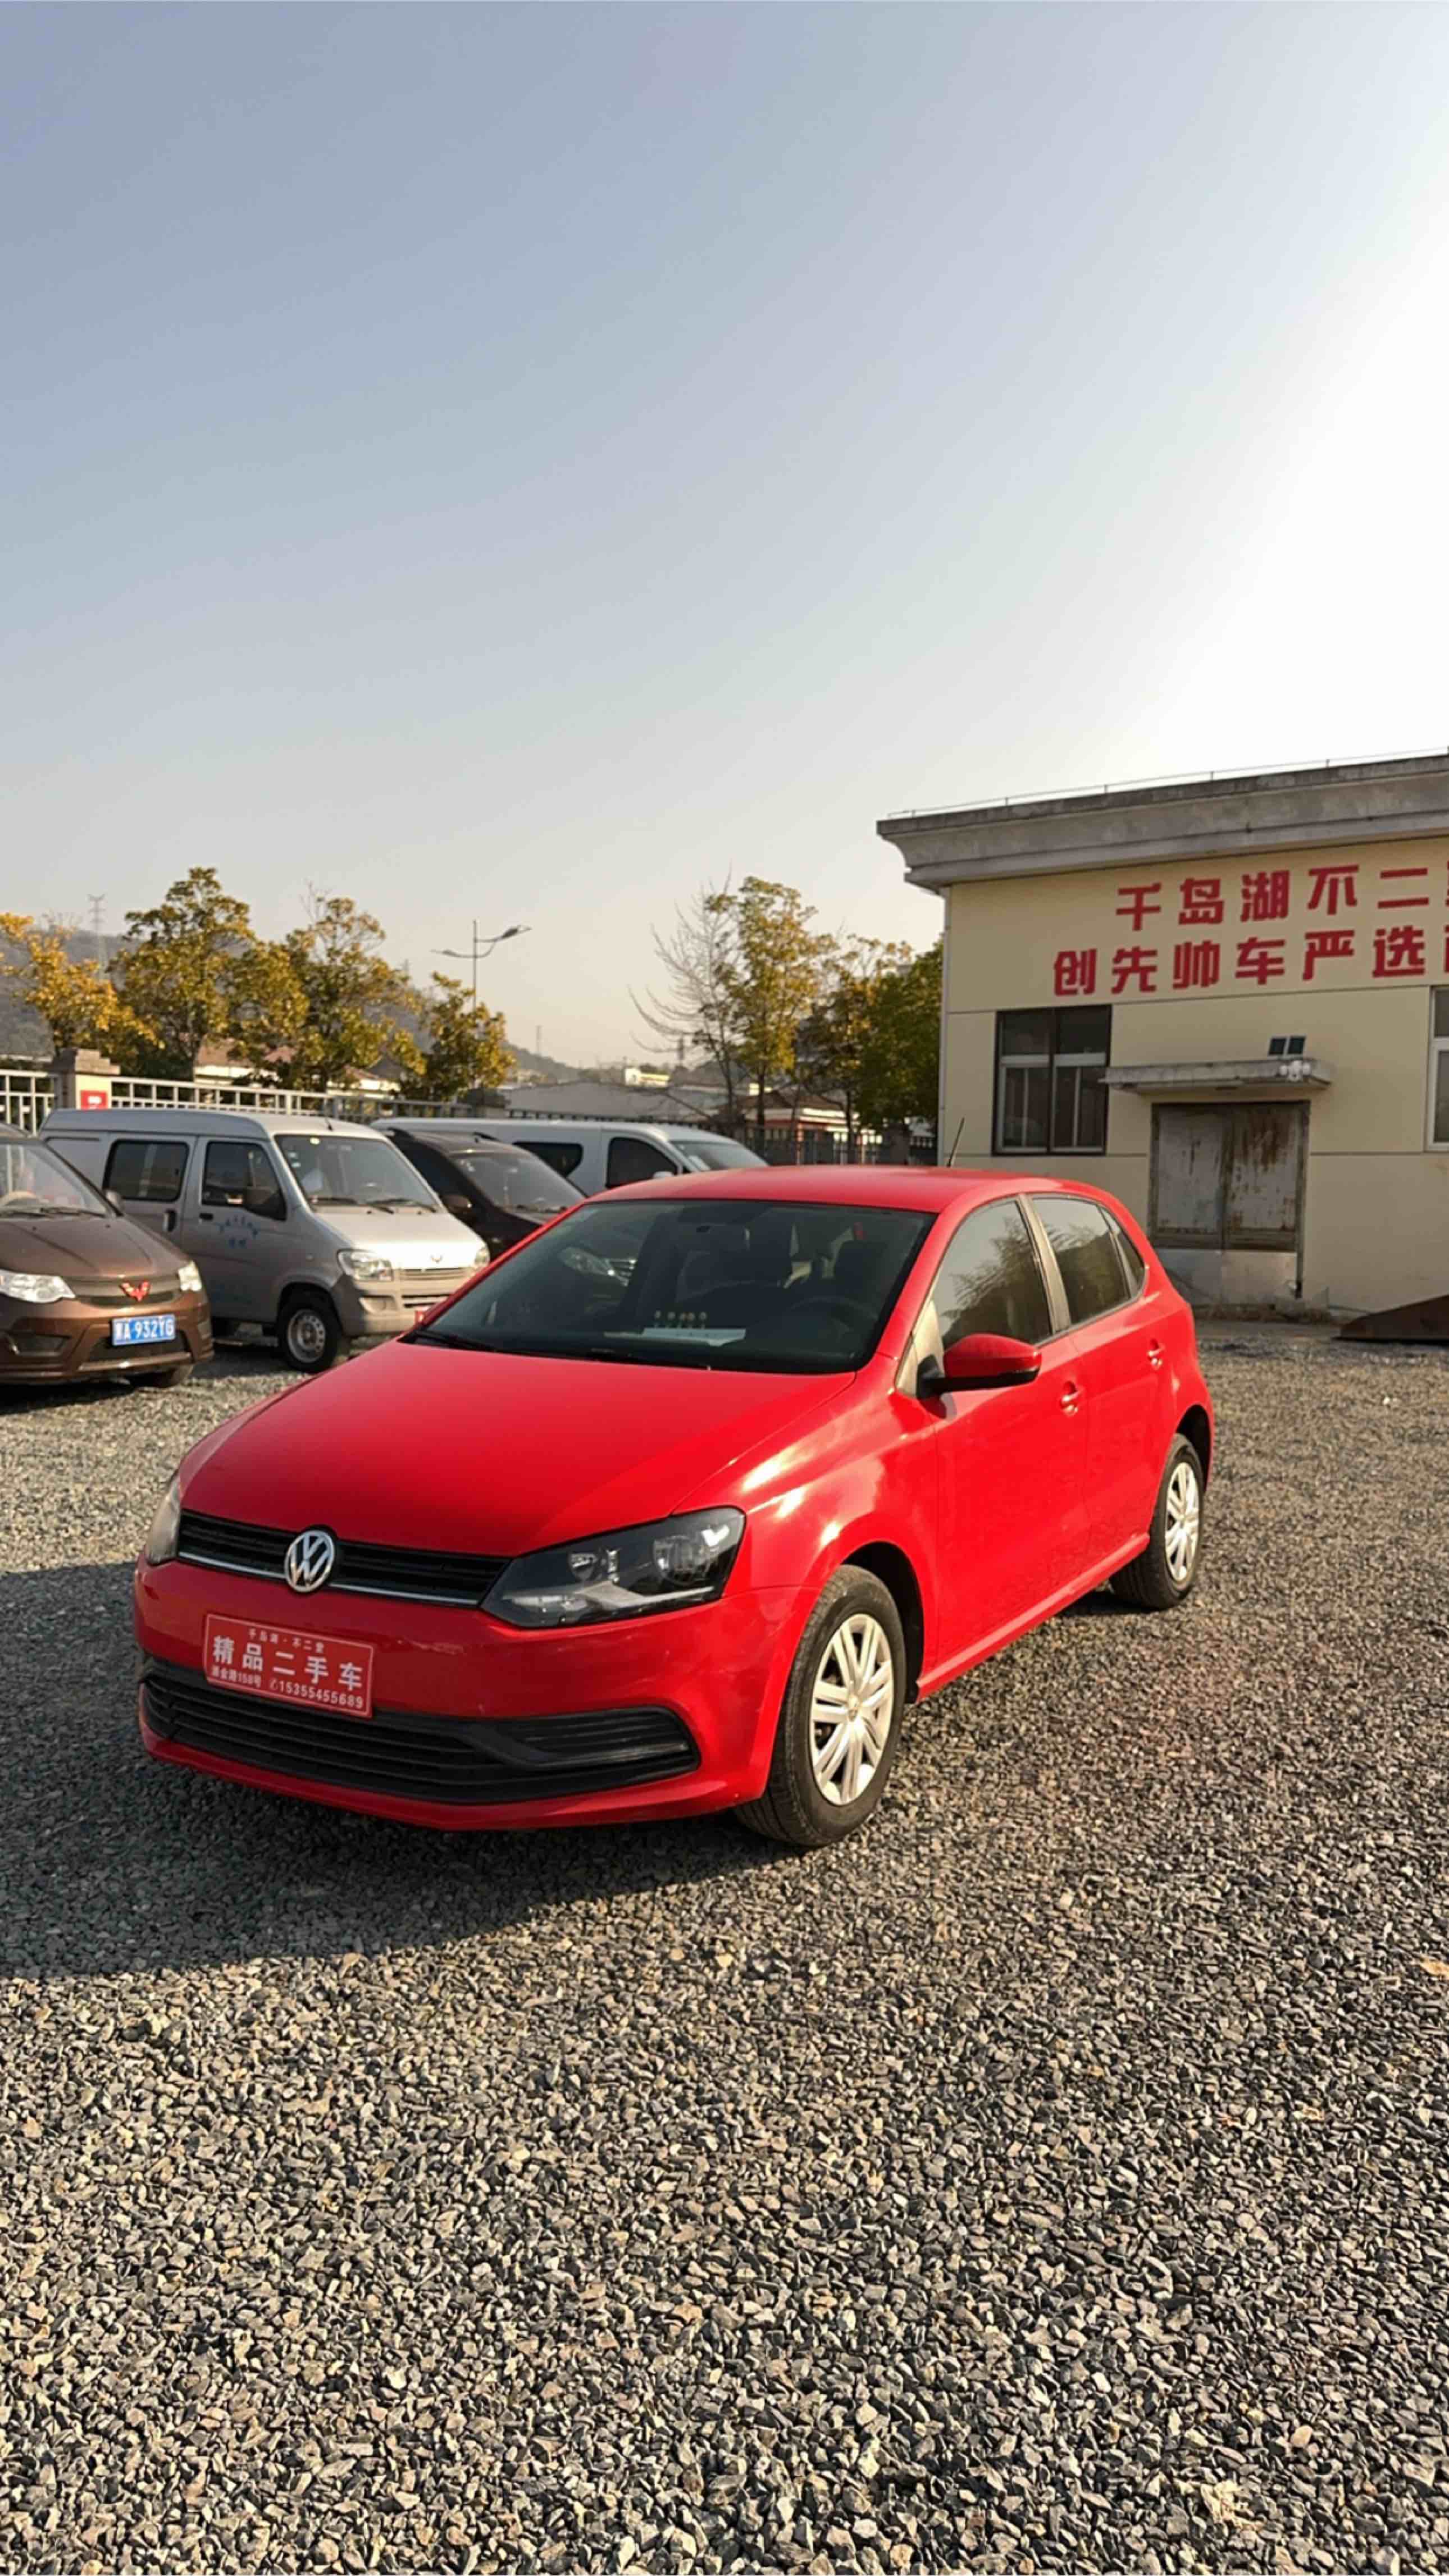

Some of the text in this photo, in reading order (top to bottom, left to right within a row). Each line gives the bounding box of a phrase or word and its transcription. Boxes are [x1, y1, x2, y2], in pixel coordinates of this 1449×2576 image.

[1115, 860, 1449, 931] 千岛湖不二
[1054, 925, 1449, 996] 创先帅车严选
[212, 1635, 363, 1691] 精品二手车
[280, 1680, 363, 1709] 15355455689
